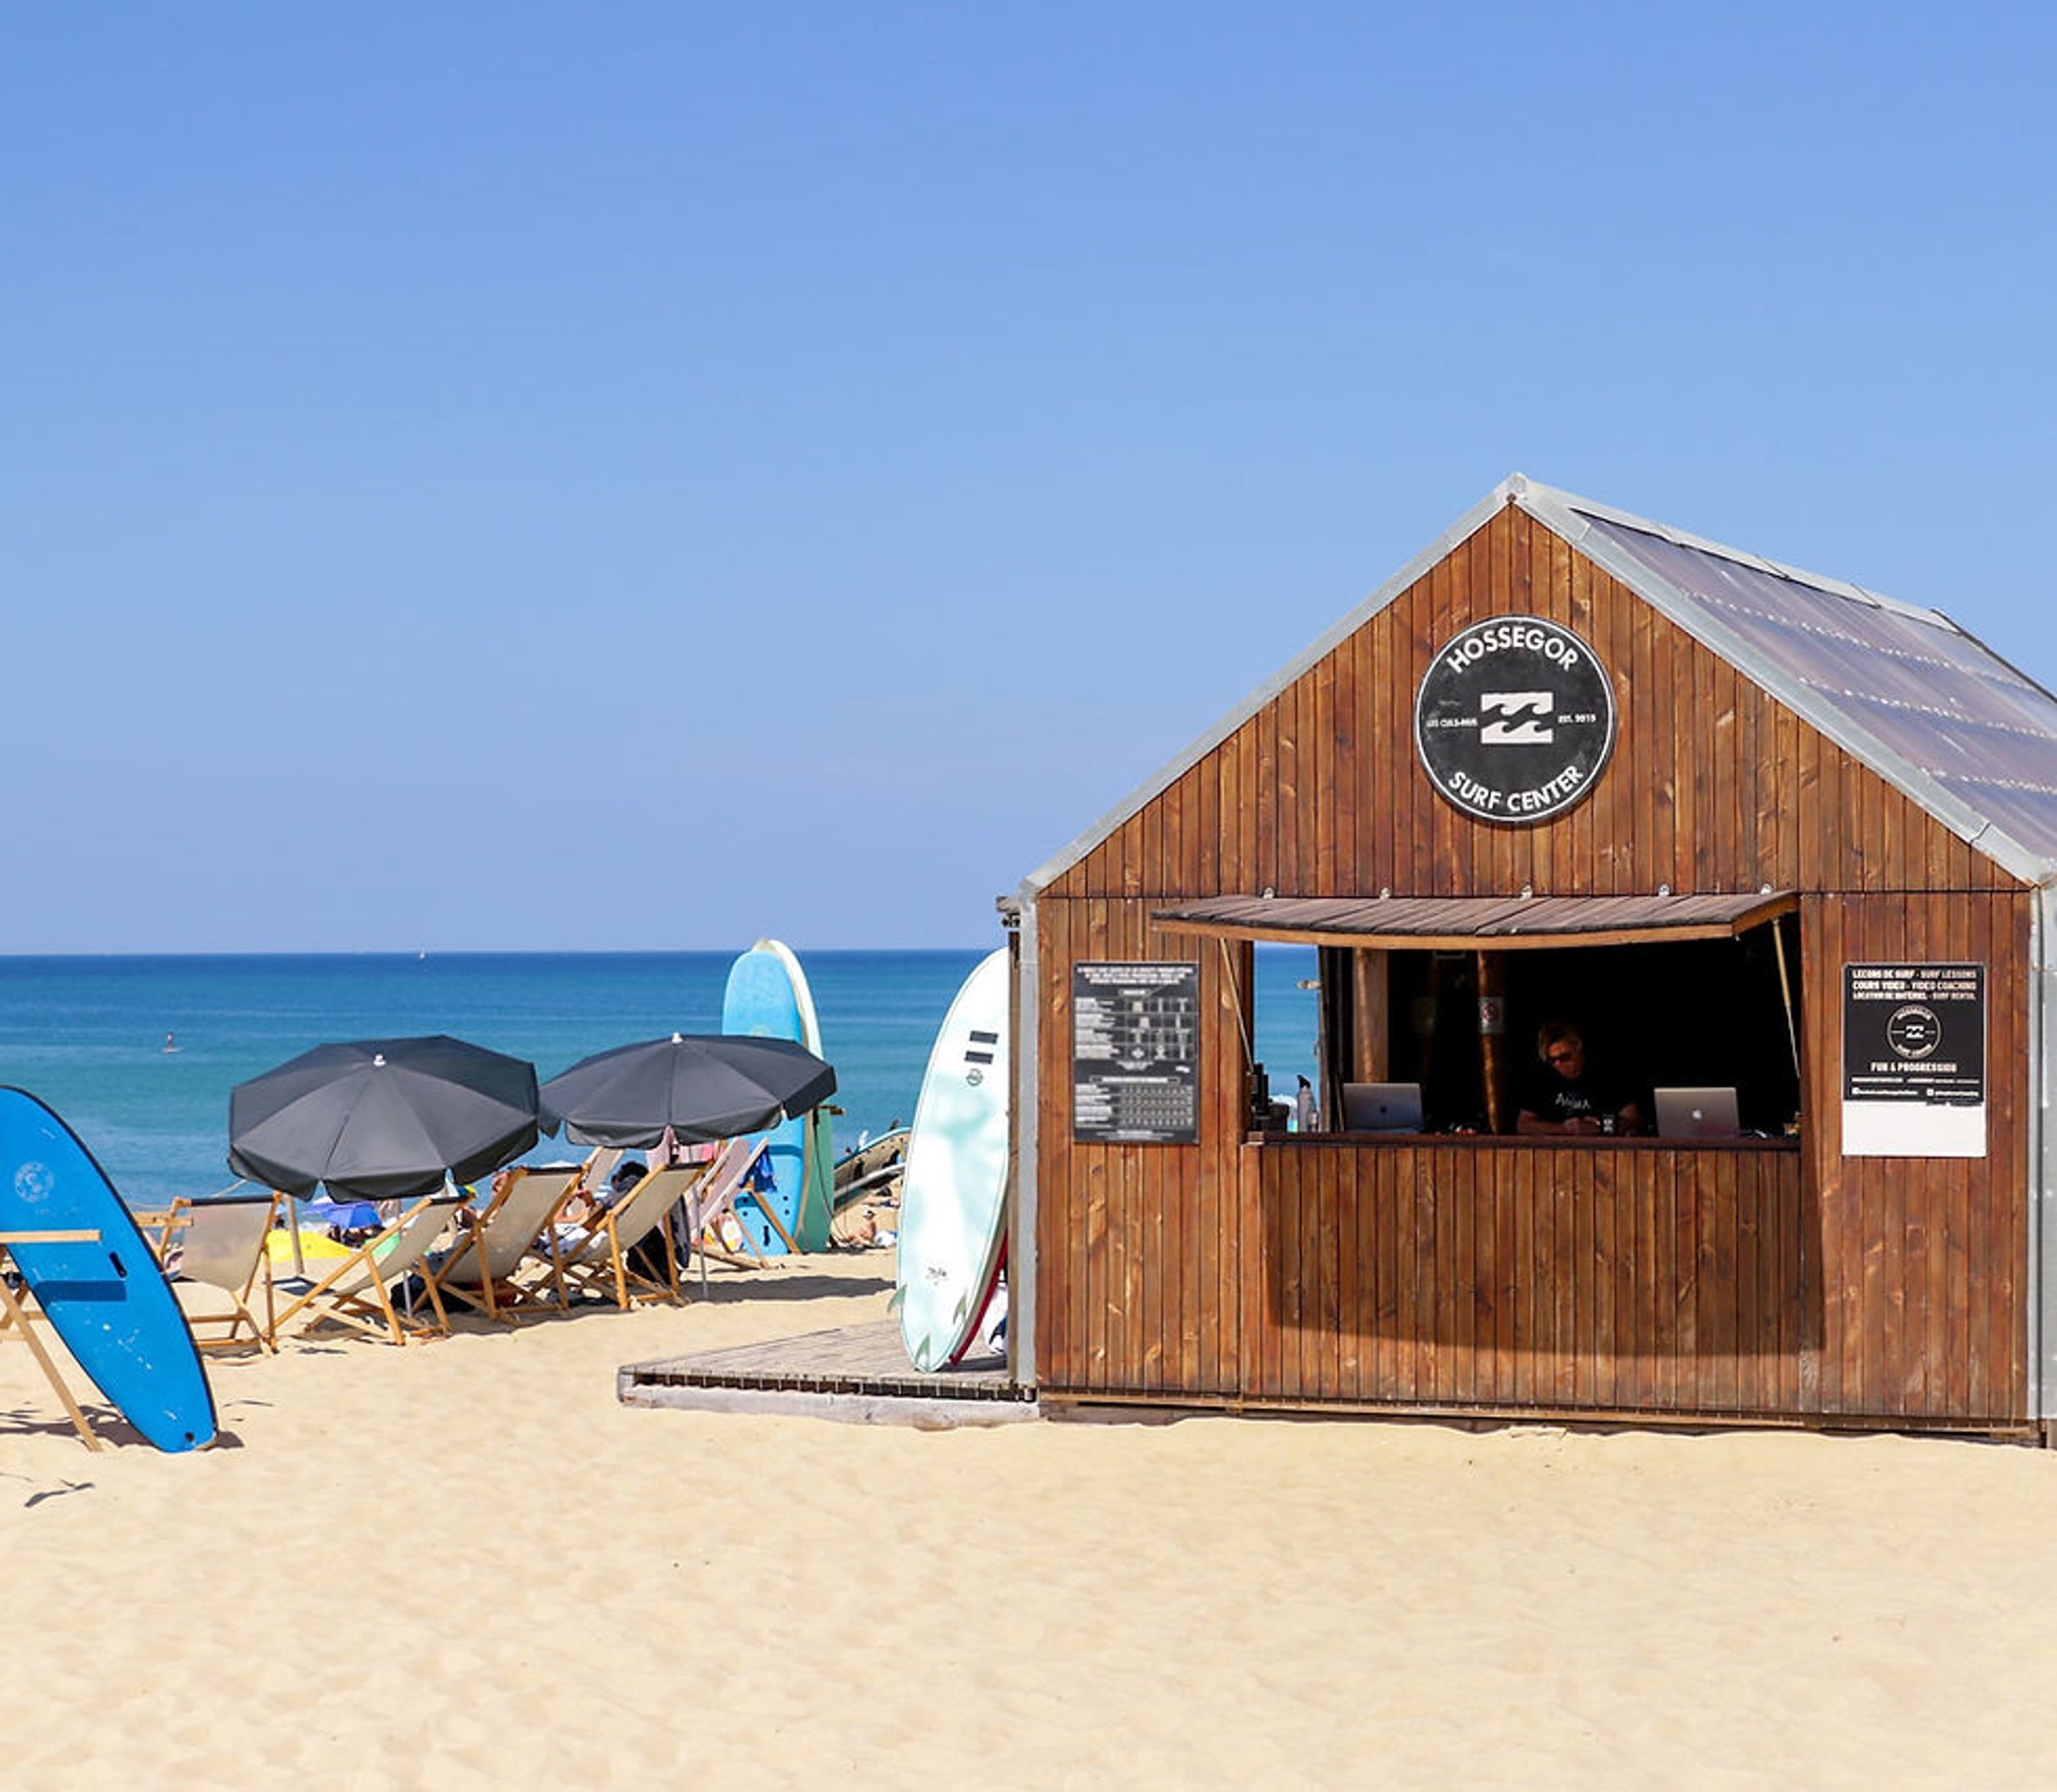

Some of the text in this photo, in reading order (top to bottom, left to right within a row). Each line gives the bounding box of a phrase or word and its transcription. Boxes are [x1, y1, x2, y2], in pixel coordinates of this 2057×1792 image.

[1446, 626, 1578, 673] HOSSEGOR
[1448, 766, 1584, 812] SURF CENTER
[1921, 969, 1940, 979] SURF
[1870, 1062, 1888, 1072] FUN
[1897, 1062, 1958, 1074] PROGRESSION
